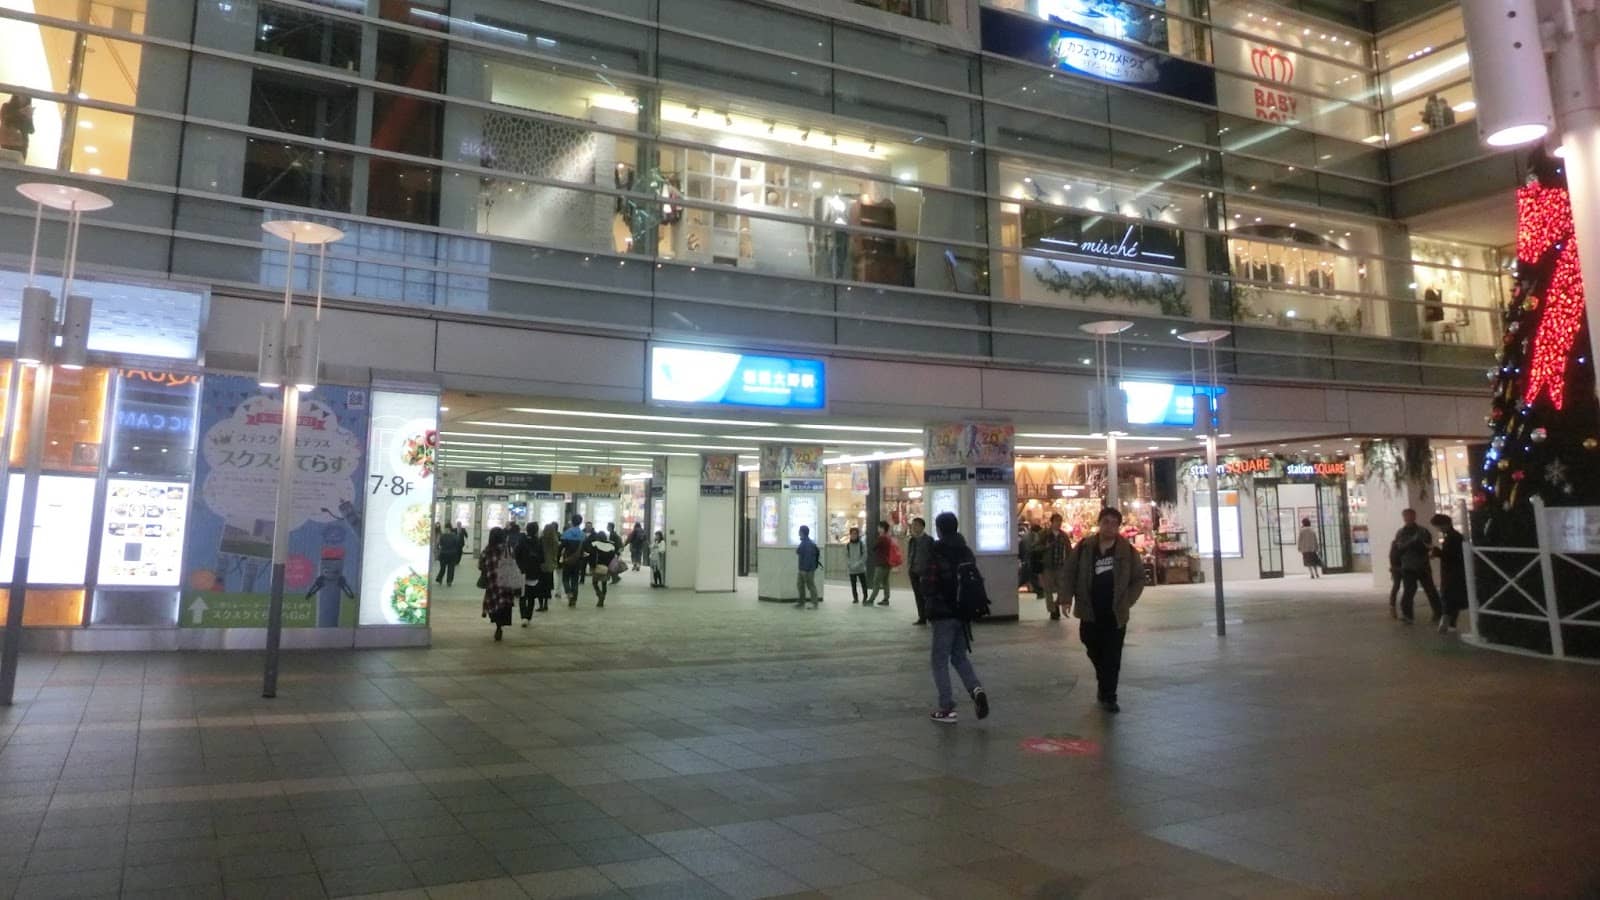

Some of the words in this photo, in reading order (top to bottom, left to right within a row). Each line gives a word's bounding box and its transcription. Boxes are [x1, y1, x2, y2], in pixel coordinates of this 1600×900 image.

[1254, 88, 1297, 115] BABY
[1190, 463, 1225, 476] statn
[1225, 457, 1271, 475] SQUARE
[1287, 463, 1314, 475] station
[1314, 463, 1345, 477] SQUARE
